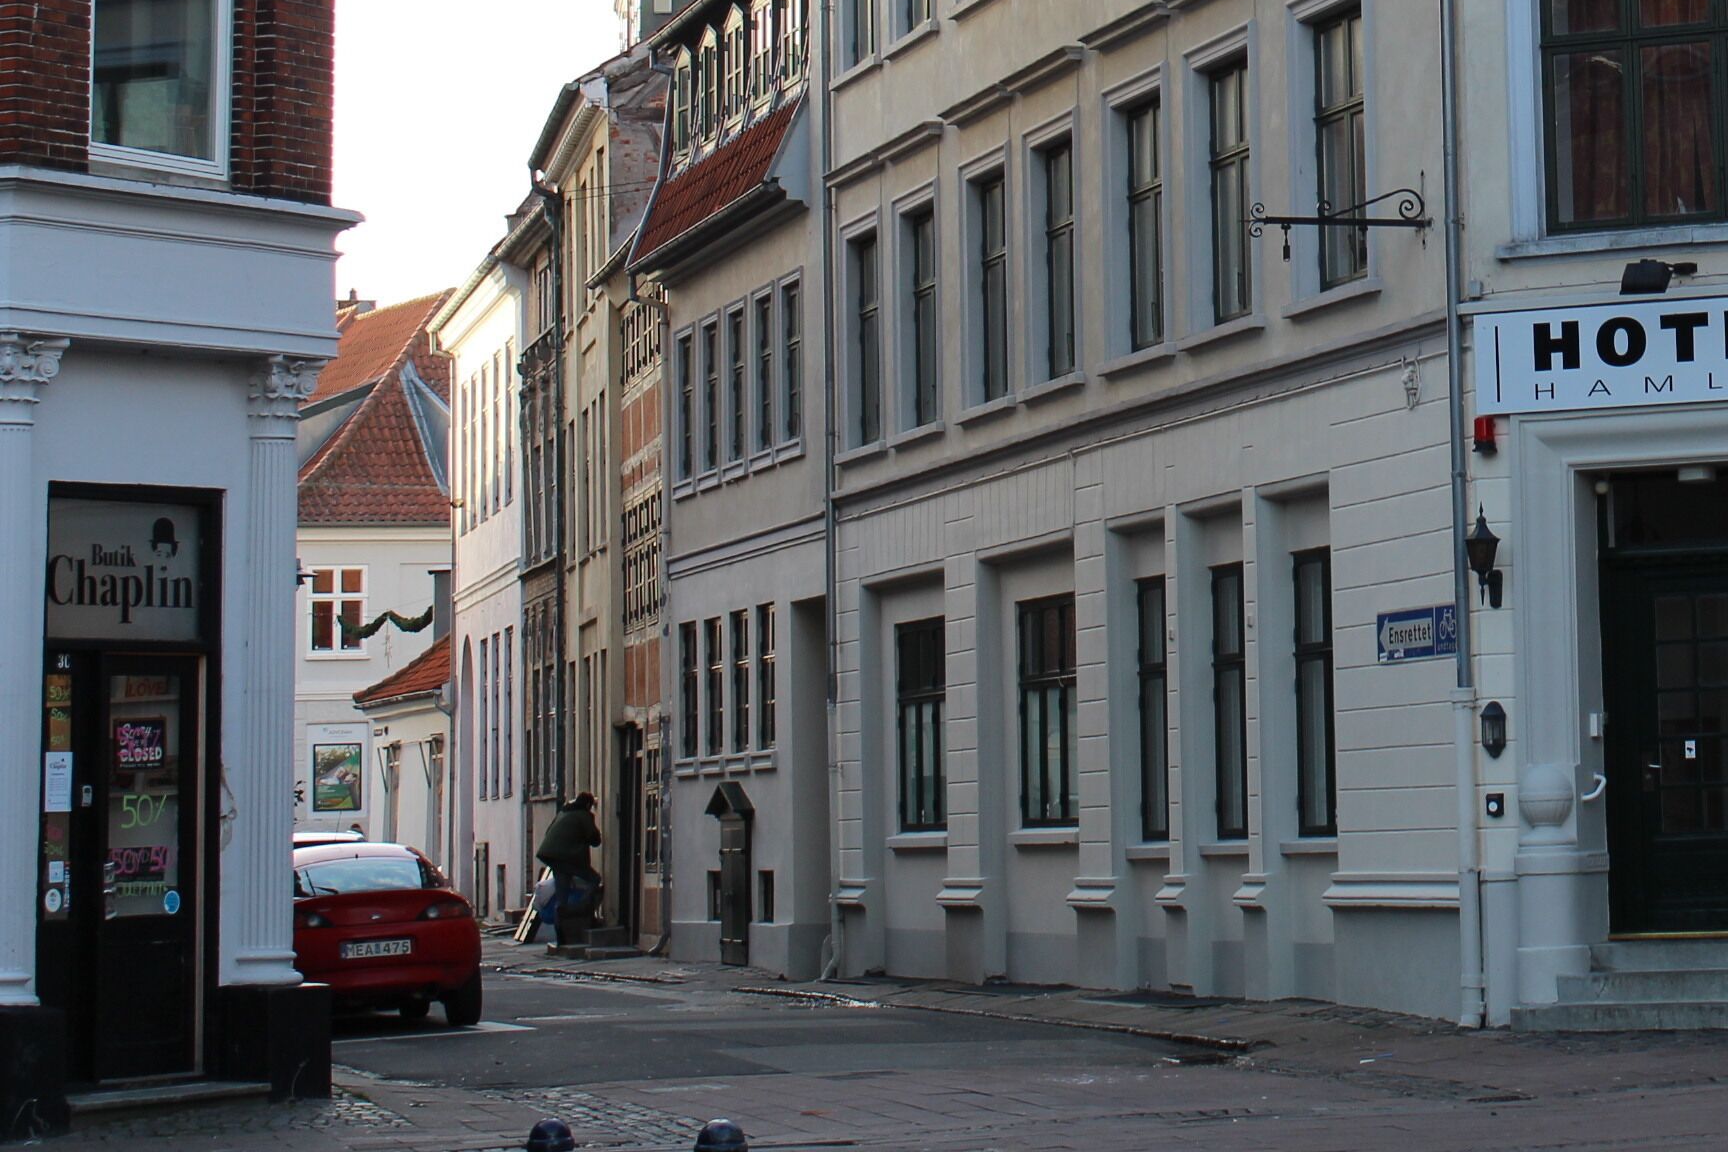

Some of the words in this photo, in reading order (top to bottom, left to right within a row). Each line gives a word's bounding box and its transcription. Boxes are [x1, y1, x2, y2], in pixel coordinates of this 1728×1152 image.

[92, 544, 136, 567] Butik
[49, 554, 194, 624] Chaplin
[1389, 623, 1431, 644] Ensrettet
[120, 746, 162, 762] CLOSED
[383, 941, 410, 954] 475
